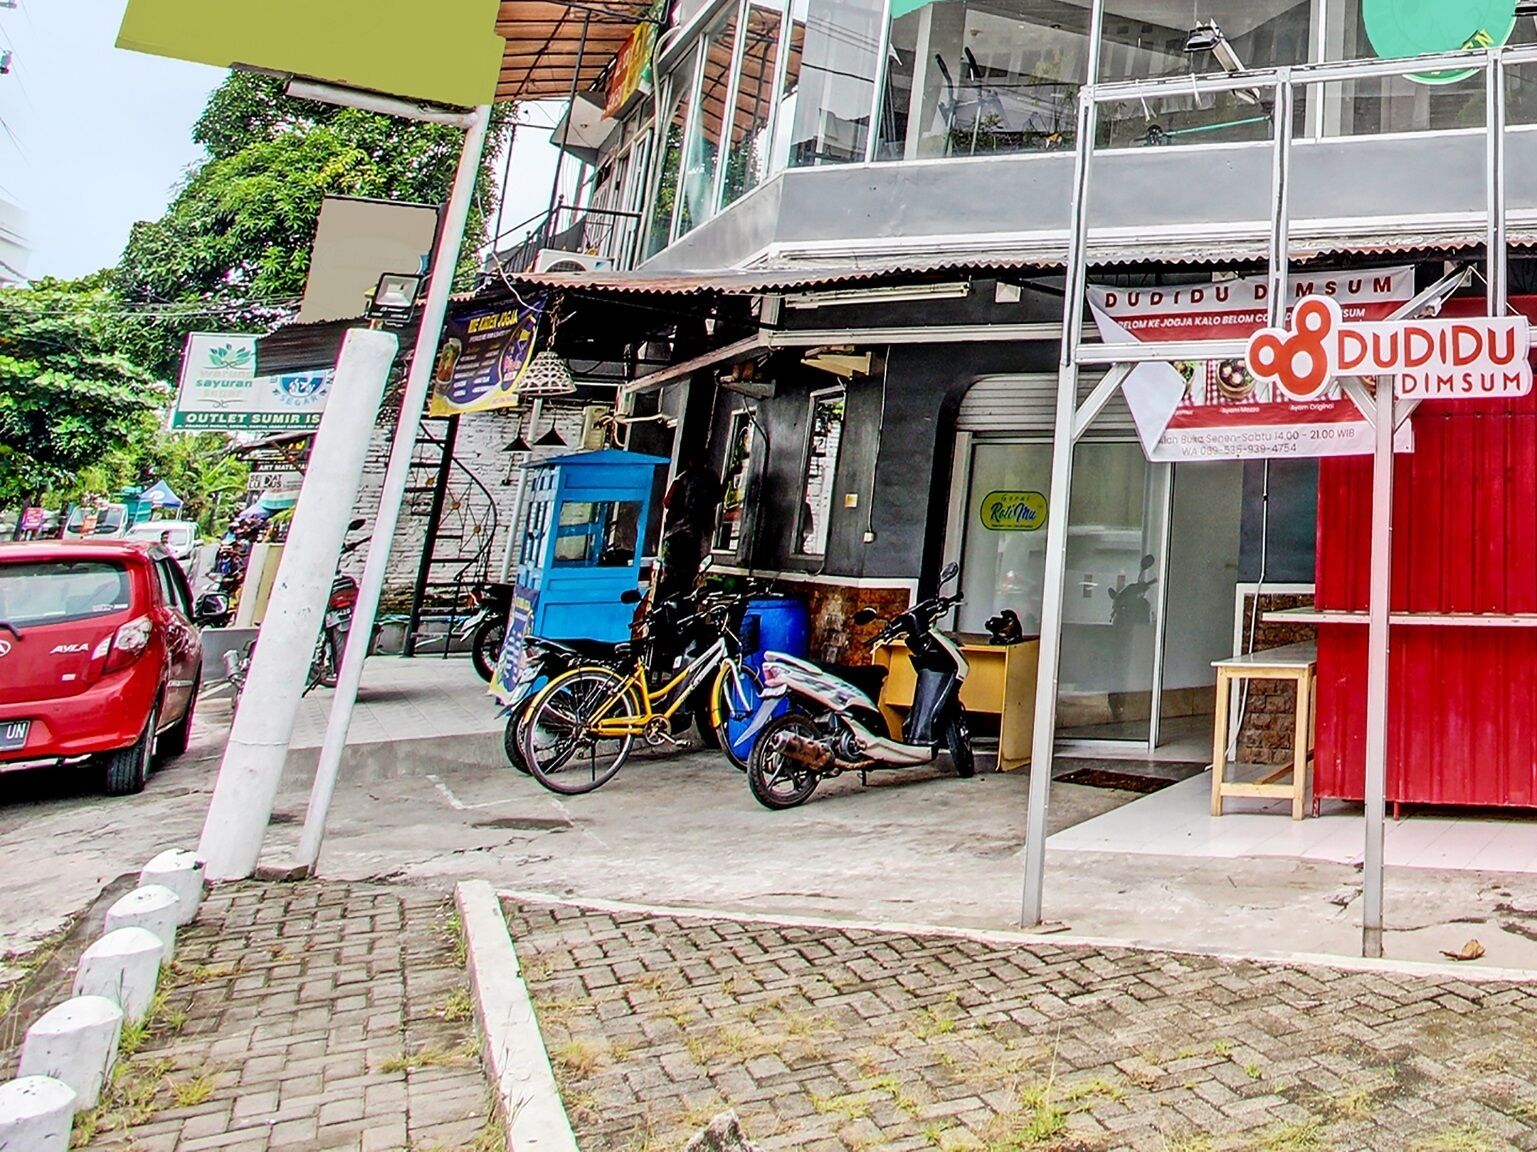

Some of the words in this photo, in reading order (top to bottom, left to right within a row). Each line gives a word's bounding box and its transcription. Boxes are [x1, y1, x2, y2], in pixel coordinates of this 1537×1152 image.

[1105, 286, 1229, 308] DUDIDU
[1254, 276, 1392, 300] DMSUM
[1148, 316, 1160, 328] KE
[1160, 316, 1193, 328] JOGJA
[1194, 315, 1220, 327] KALO
[1221, 313, 1254, 325] BELOM
[1338, 324, 1515, 370] DUDIDU
[195, 378, 253, 389] sayuran
[1402, 372, 1521, 394] DIMSUM
[186, 413, 247, 424] OUTLET
[251, 413, 300, 424] SUMIR
[1310, 429, 1335, 440] 21.00
[1336, 428, 1355, 438] WIB
[50, 643, 89, 654] AYLA
[6, 723, 26, 740] UN
